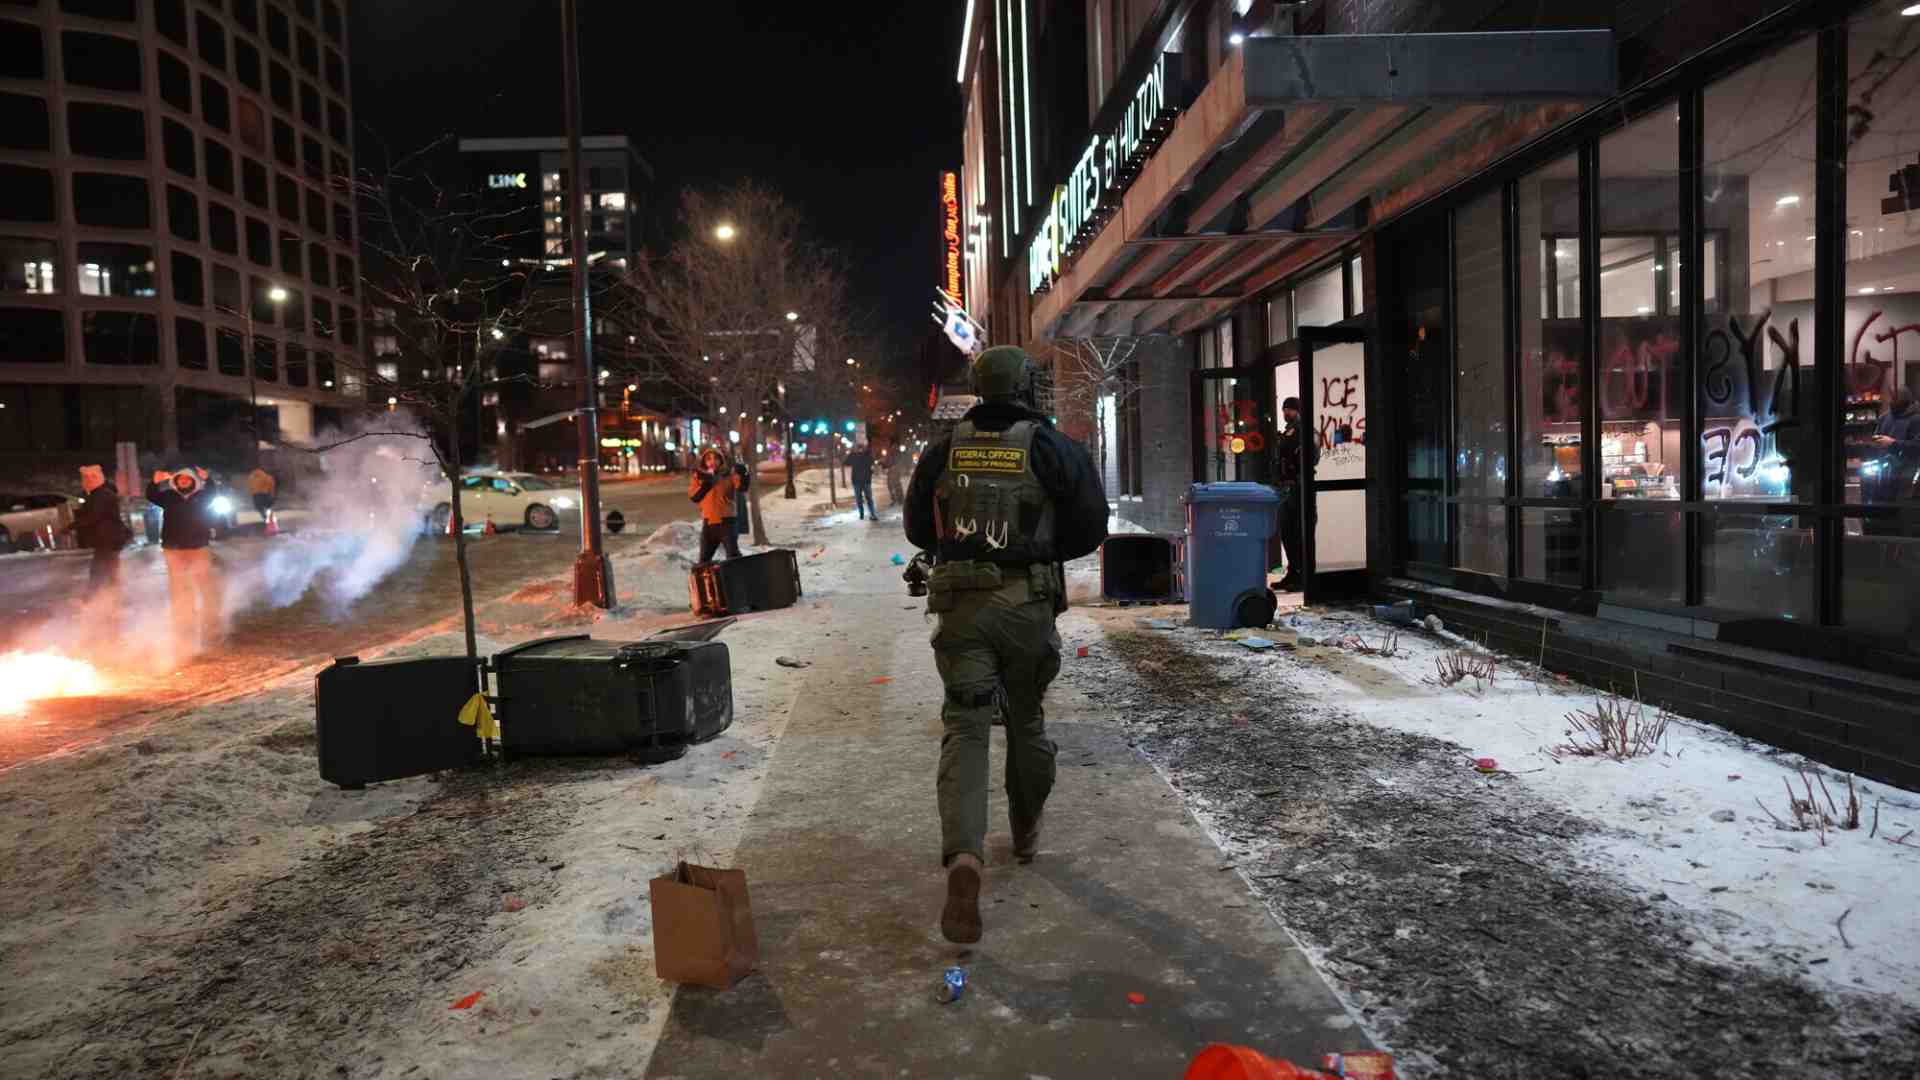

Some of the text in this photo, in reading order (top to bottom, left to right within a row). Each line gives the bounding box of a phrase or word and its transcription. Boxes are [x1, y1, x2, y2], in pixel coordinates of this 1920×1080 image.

[1060, 133, 1100, 255] SUITES
[1105, 127, 1118, 189] BY
[1119, 52, 1165, 168] HILTON
[1322, 374, 1359, 416] ICE
[954, 450, 1021, 460] FEDERAL OFFICER
